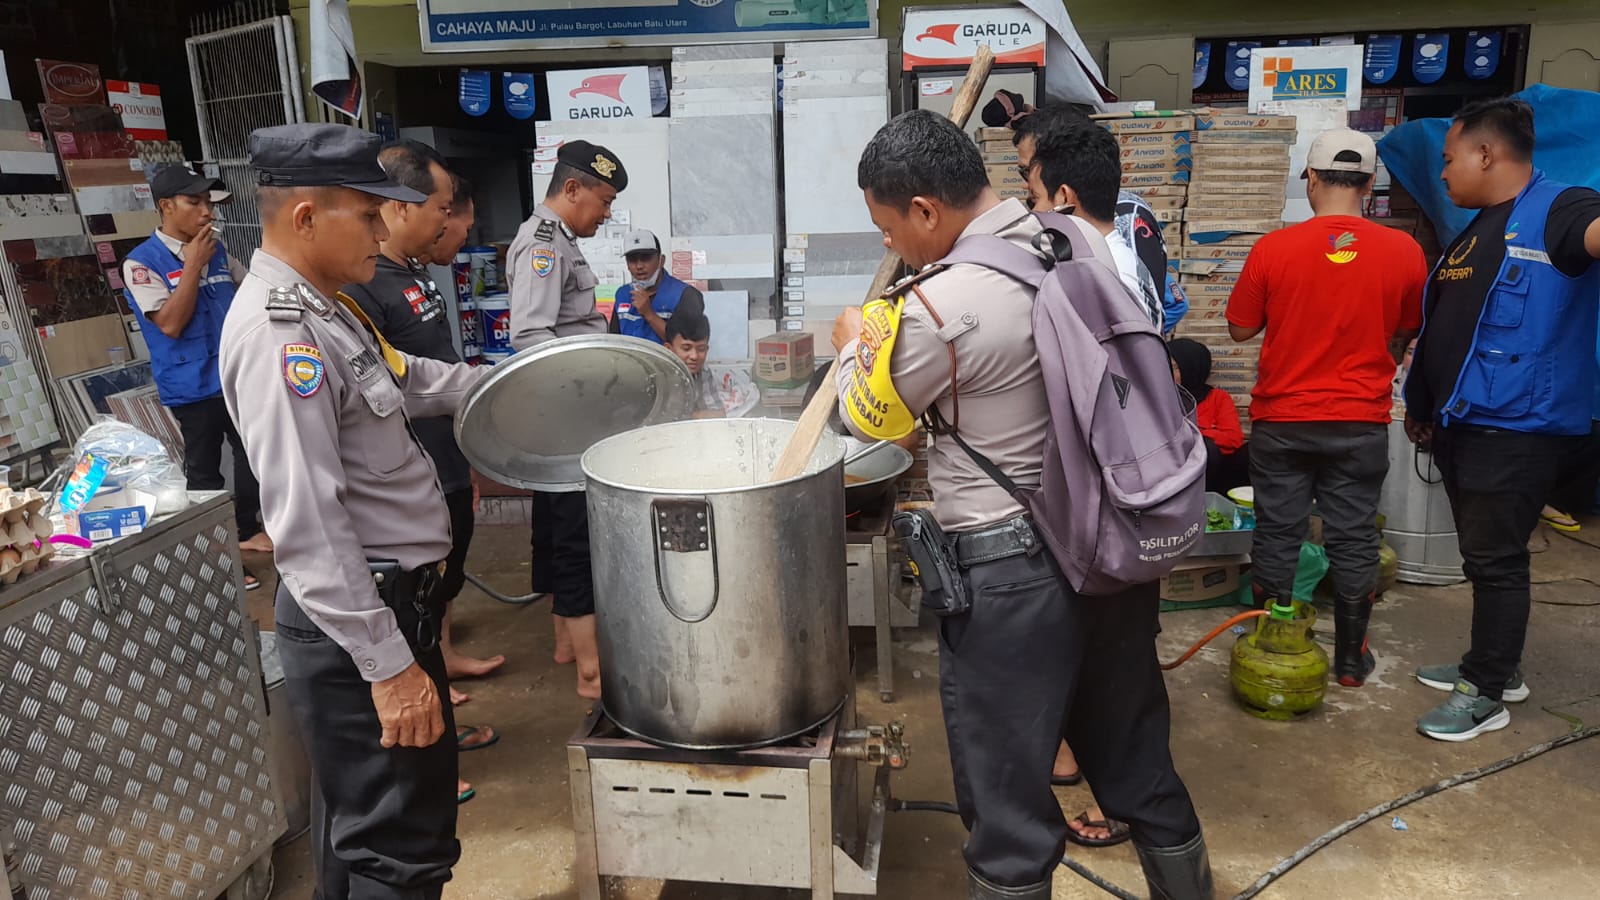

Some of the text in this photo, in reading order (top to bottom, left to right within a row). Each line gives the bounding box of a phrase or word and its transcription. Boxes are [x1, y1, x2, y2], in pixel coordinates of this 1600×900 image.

[436, 22, 494, 36] CAHAYA
[497, 20, 536, 34] MAJU
[550, 22, 574, 31] Pulau
[607, 20, 642, 30] Labuhan
[644, 19, 663, 28] Batu
[665, 18, 687, 28] Utara
[963, 23, 1032, 37] GARUDA
[974, 38, 1020, 48] TILE
[1284, 73, 1337, 92] ARES
[124, 104, 162, 117] CONCORD
[569, 106, 634, 120] GARUDA
[1132, 135, 1163, 143] Arwana
[1134, 148, 1165, 157] Arwana
[1134, 162, 1165, 171] Arwana
[1132, 175, 1163, 183] Arwana
